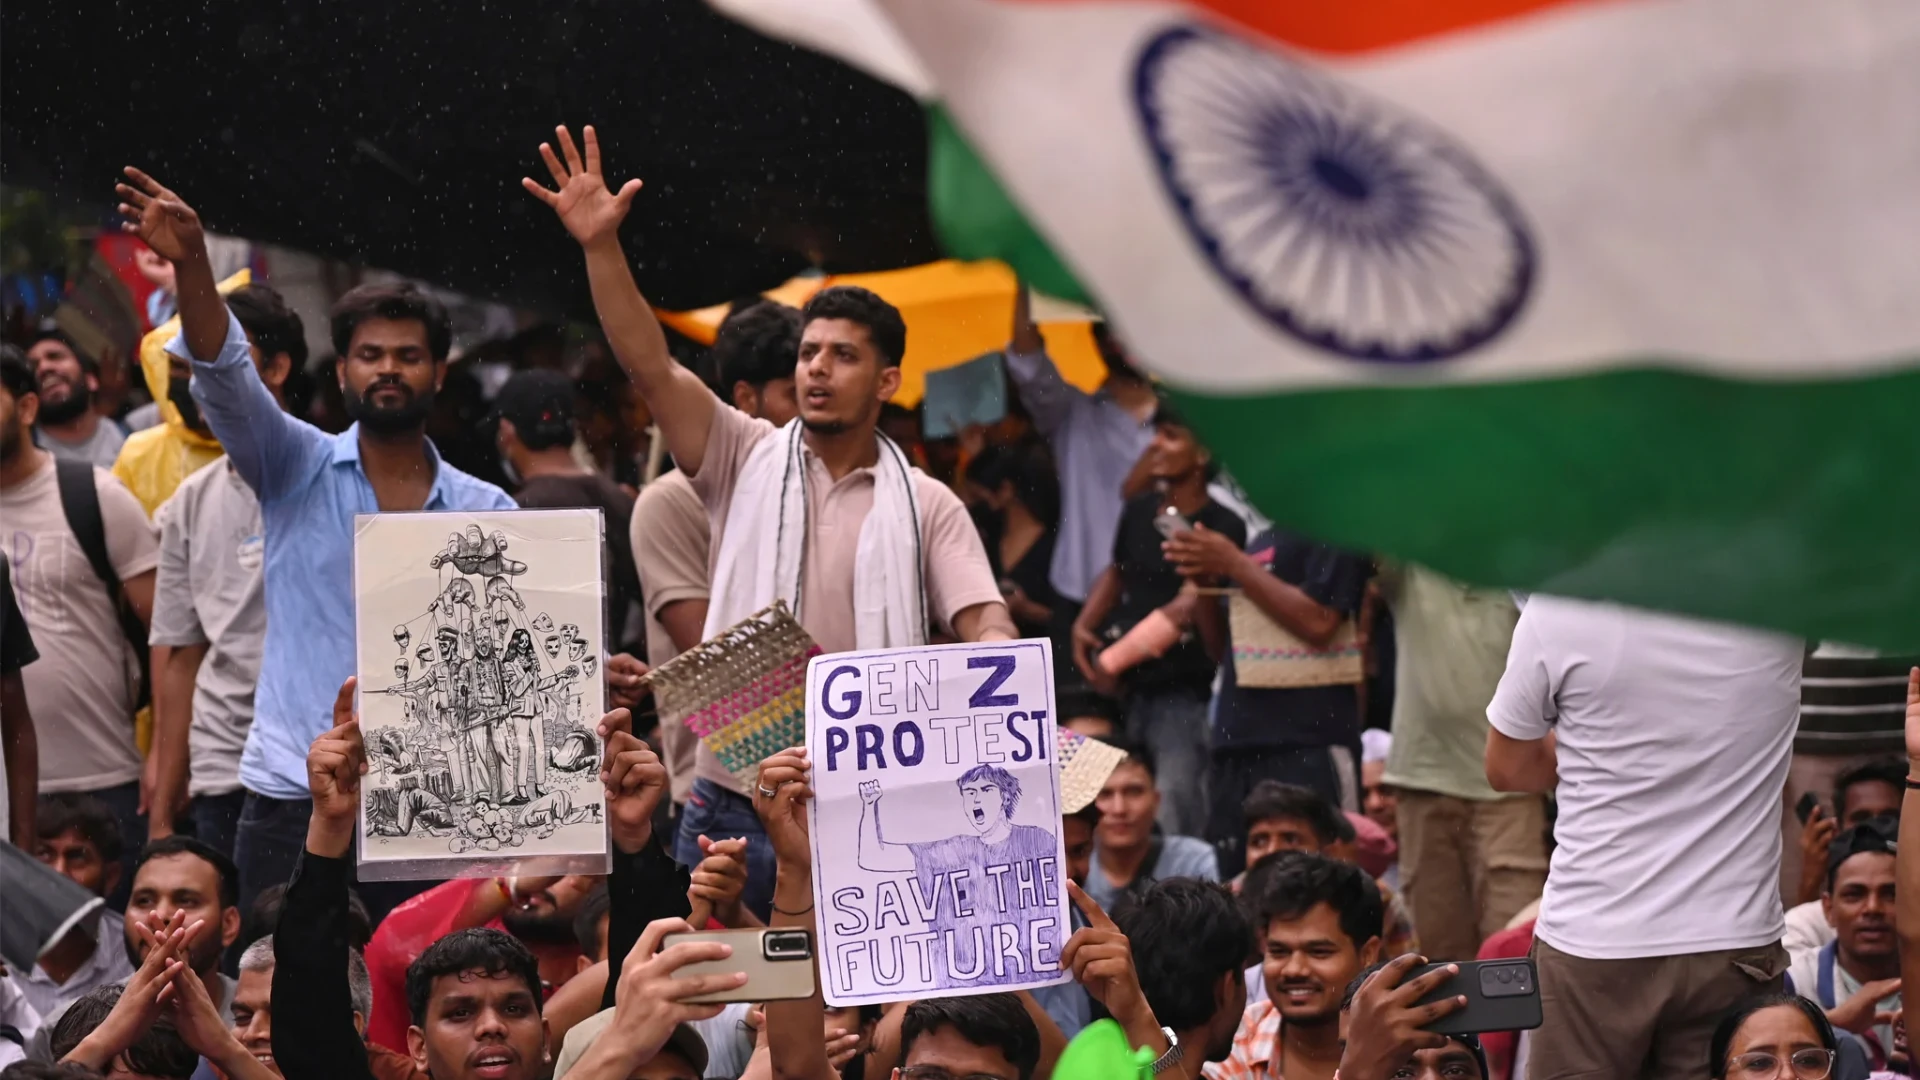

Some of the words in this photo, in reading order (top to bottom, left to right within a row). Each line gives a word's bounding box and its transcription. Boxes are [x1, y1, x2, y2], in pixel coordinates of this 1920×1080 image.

[821, 659, 939, 720] GEN
[967, 655, 1019, 709] Z
[825, 710, 1047, 771] PROTEST
[832, 869, 975, 936] SAVE
[986, 857, 1059, 914] THE
[836, 917, 1060, 991] FUTURE
